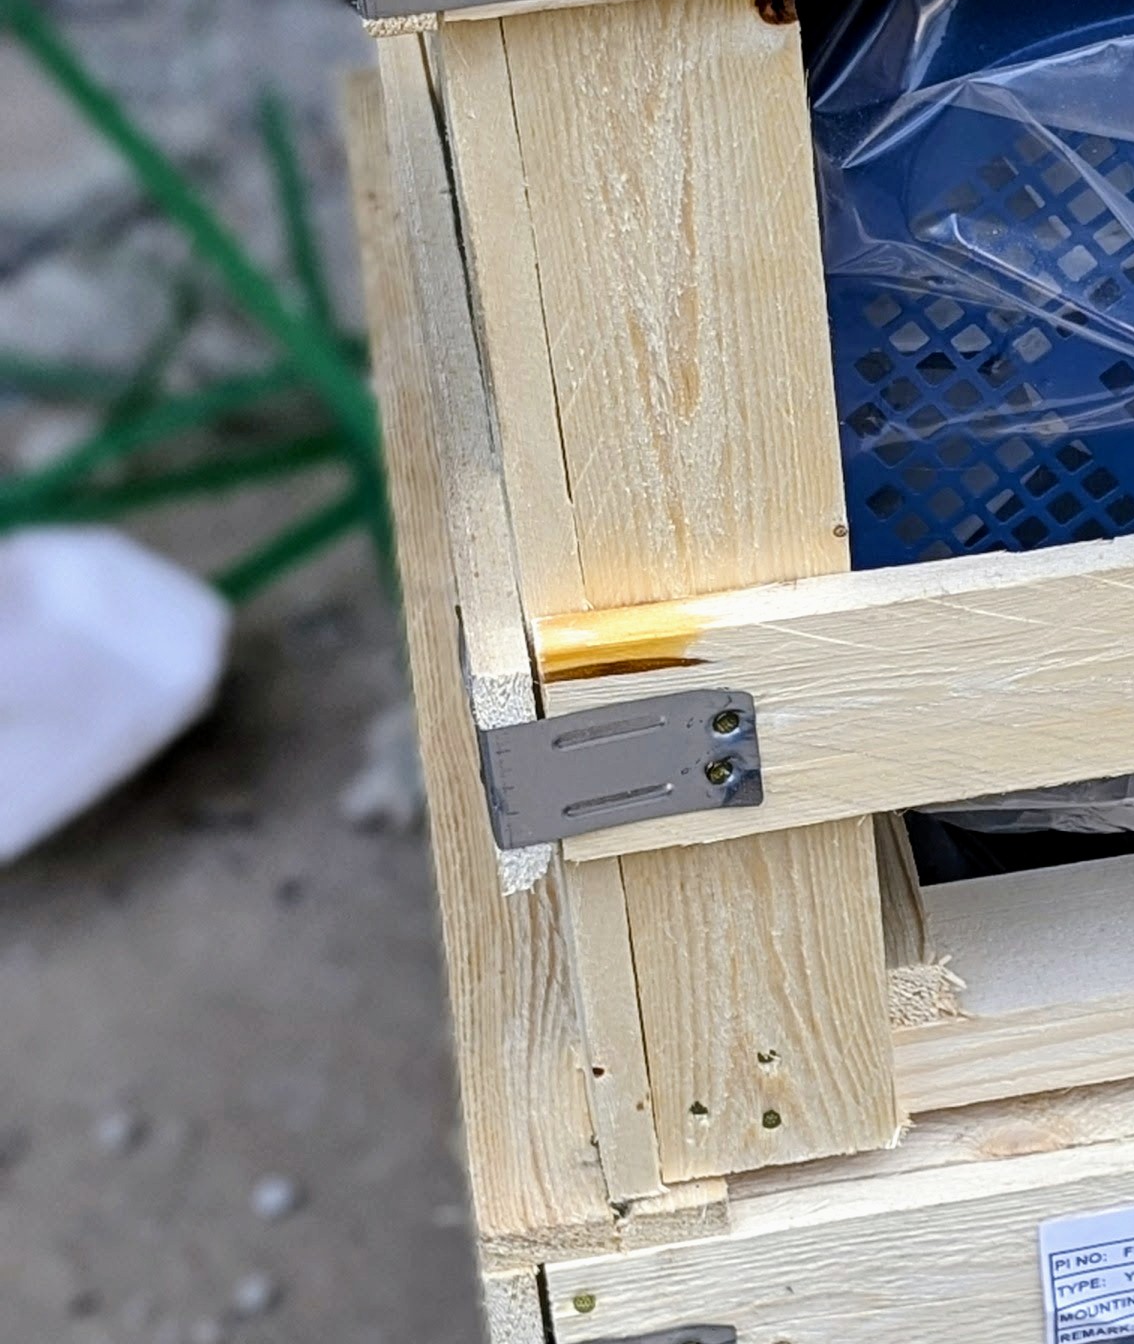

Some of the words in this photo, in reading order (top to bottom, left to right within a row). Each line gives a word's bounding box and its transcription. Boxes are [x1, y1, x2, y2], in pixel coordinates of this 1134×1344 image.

[1055, 1259, 1070, 1272] PI
[1076, 1252, 1107, 1267] NO:
[1057, 1278, 1106, 1298] TYPE:
[1060, 1324, 1134, 1344] REMARK:
